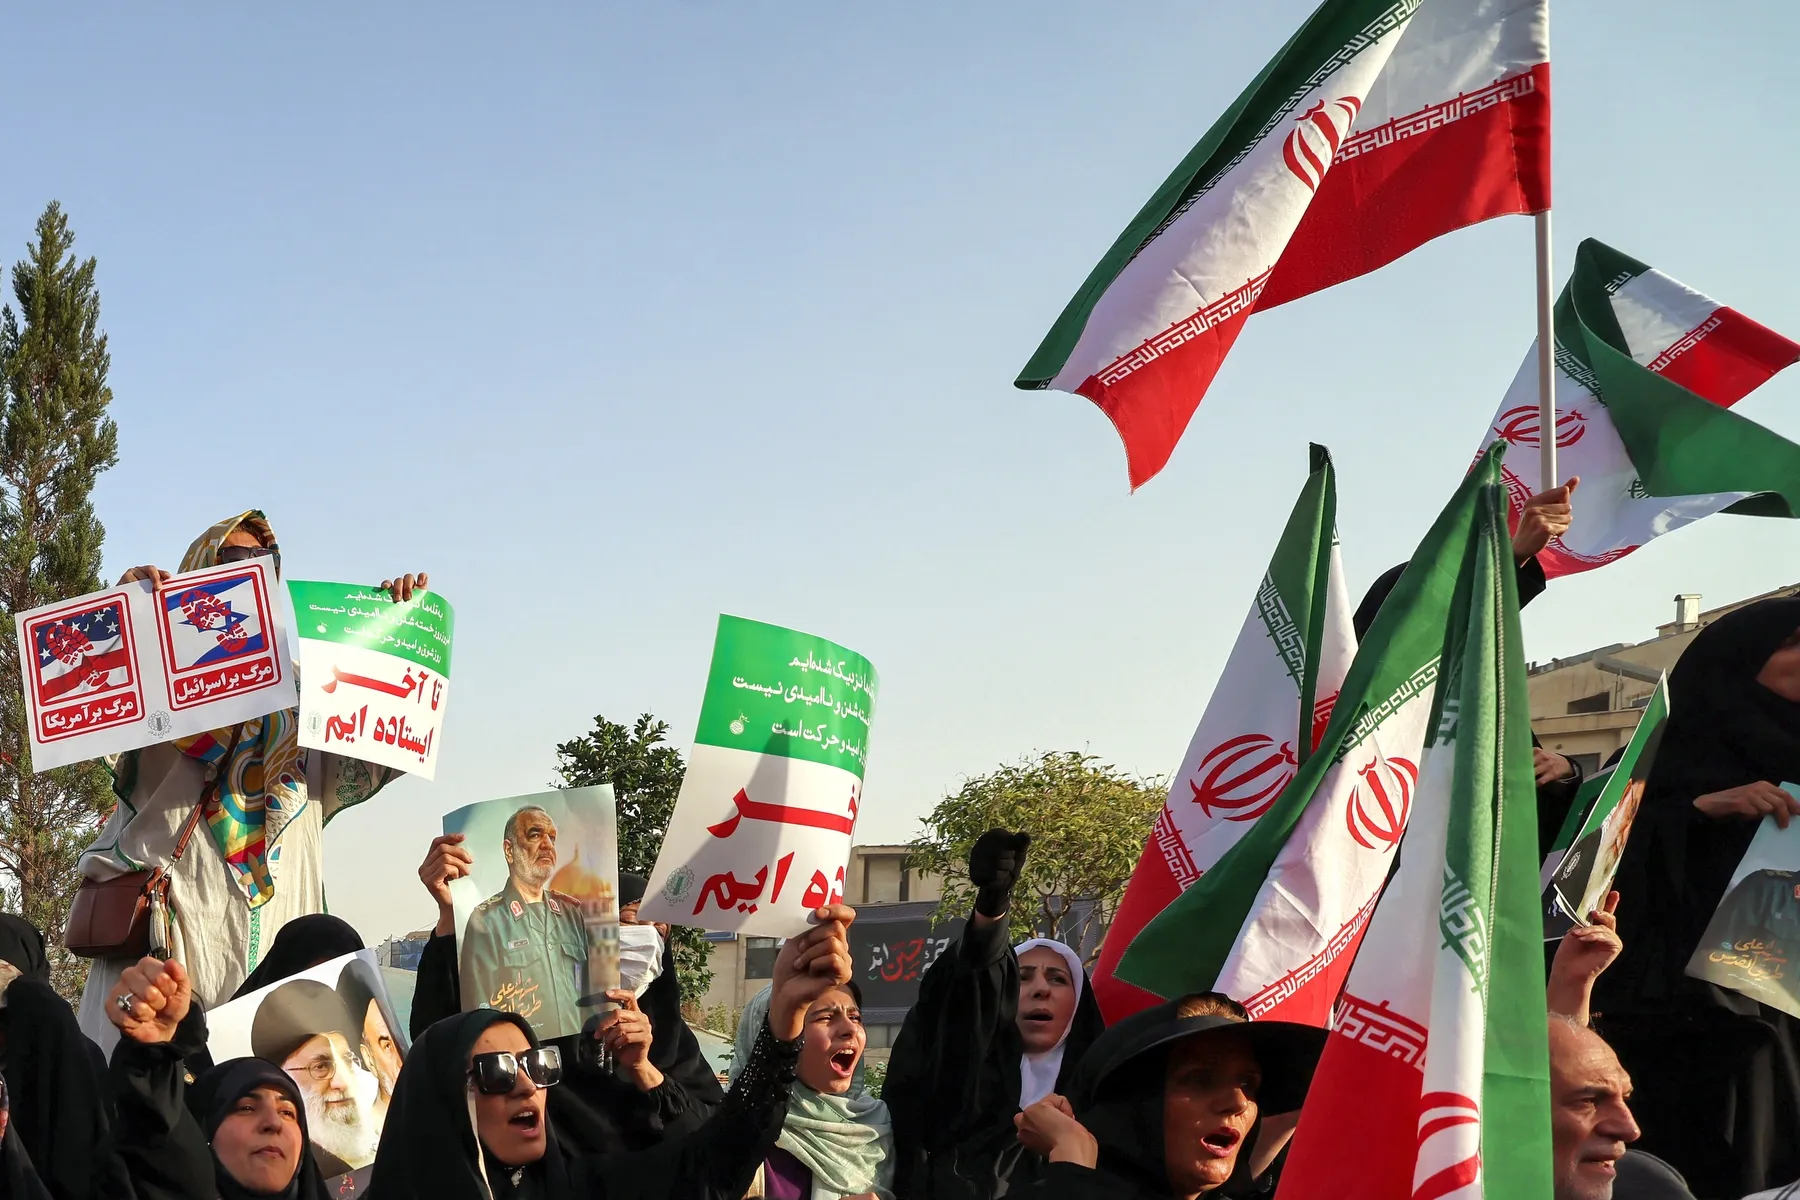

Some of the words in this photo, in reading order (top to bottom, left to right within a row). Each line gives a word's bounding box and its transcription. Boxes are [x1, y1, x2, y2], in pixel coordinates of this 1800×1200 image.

[309, 603, 346, 614] نیست
[227, 674, 239, 689] بر
[242, 665, 272, 682] مرگ
[321, 664, 429, 704] آخر
[176, 675, 226, 701] اسرائیل
[431, 679, 443, 711] تا
[732, 676, 783, 698] نیست
[784, 685, 833, 707] ناامیدی
[45, 704, 90, 730] آمریکا
[91, 707, 103, 723] بر
[104, 699, 134, 716] مرگ
[325, 705, 368, 743] ایم
[772, 719, 803, 738] است
[374, 715, 434, 763] ایستاده
[692, 851, 795, 915] ایم
